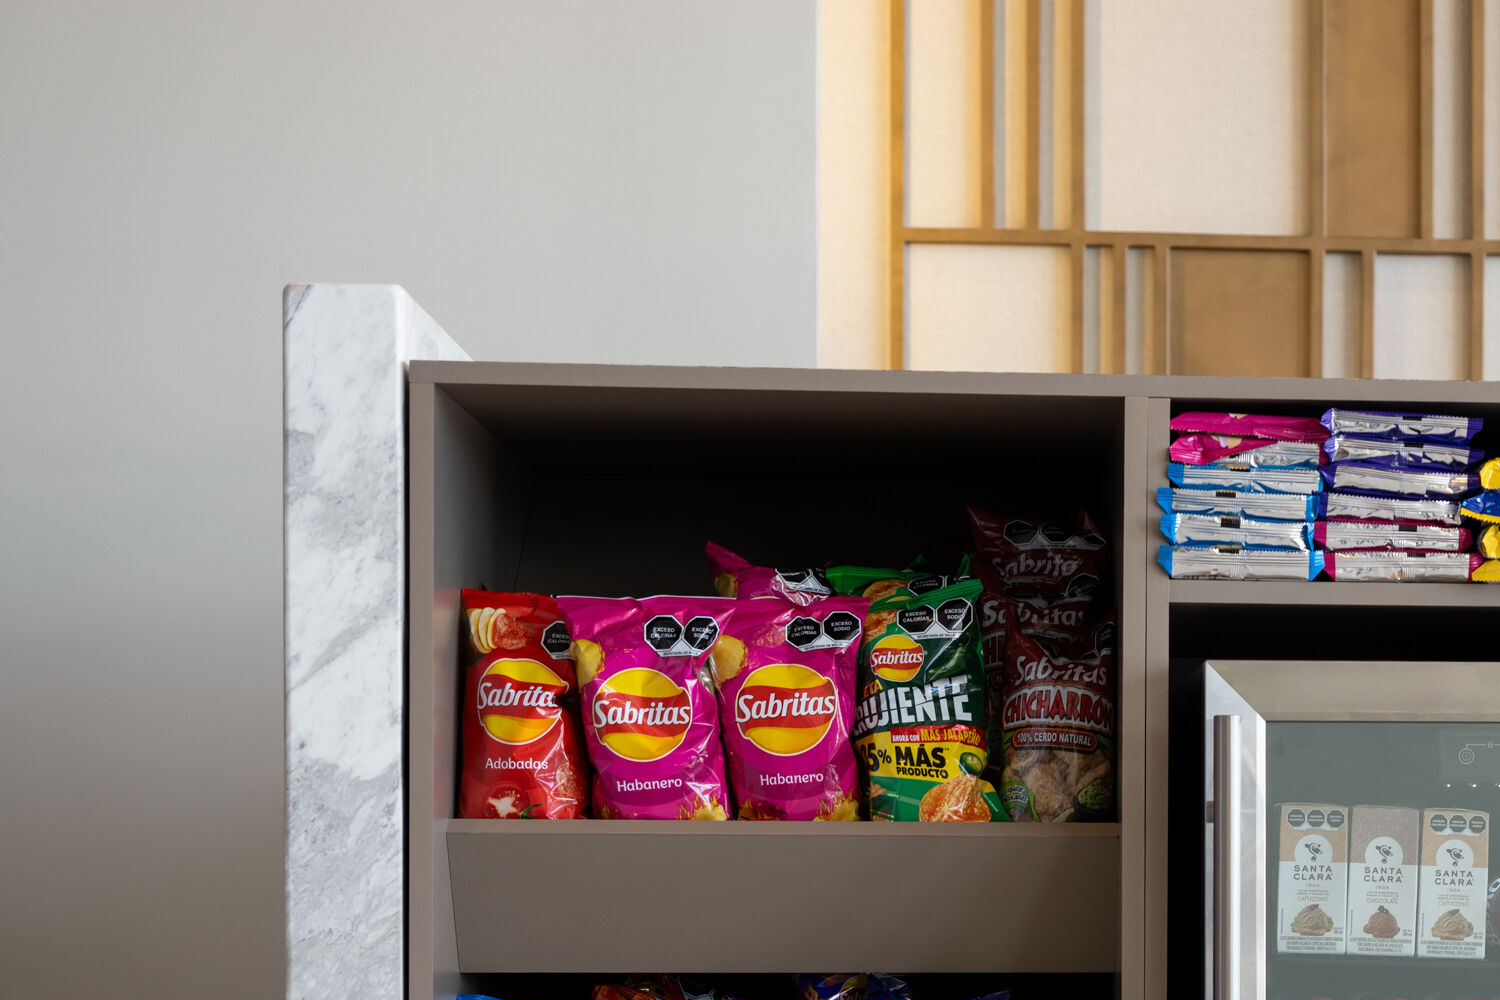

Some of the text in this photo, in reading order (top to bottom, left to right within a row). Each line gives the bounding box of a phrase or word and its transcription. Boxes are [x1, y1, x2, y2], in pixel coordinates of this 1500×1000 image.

[871, 647, 924, 668] Sabritas
[1015, 656, 1106, 687] Sabritas
[477, 681, 558, 709] Sabrita
[735, 692, 835, 724] Sabritas
[853, 674, 973, 736] RUJIENTE
[594, 699, 691, 728] Sabritas
[943, 728, 982, 746] JALAPEÑO
[1017, 732, 1092, 747] 100% CERDO NATURAL
[485, 757, 548, 770] Adobadas
[759, 772, 824, 786] Habanero
[896, 766, 948, 779] PRODUCTO
[616, 777, 683, 792] Habanero
[1293, 865, 1333, 873] SANTA
[1364, 867, 1403, 875] SANTA
[1435, 869, 1473, 878] SANTA
[1293, 873, 1333, 881] CLARA
[1363, 875, 1402, 883] CLARA
[1434, 878, 1473, 887] CLARA
